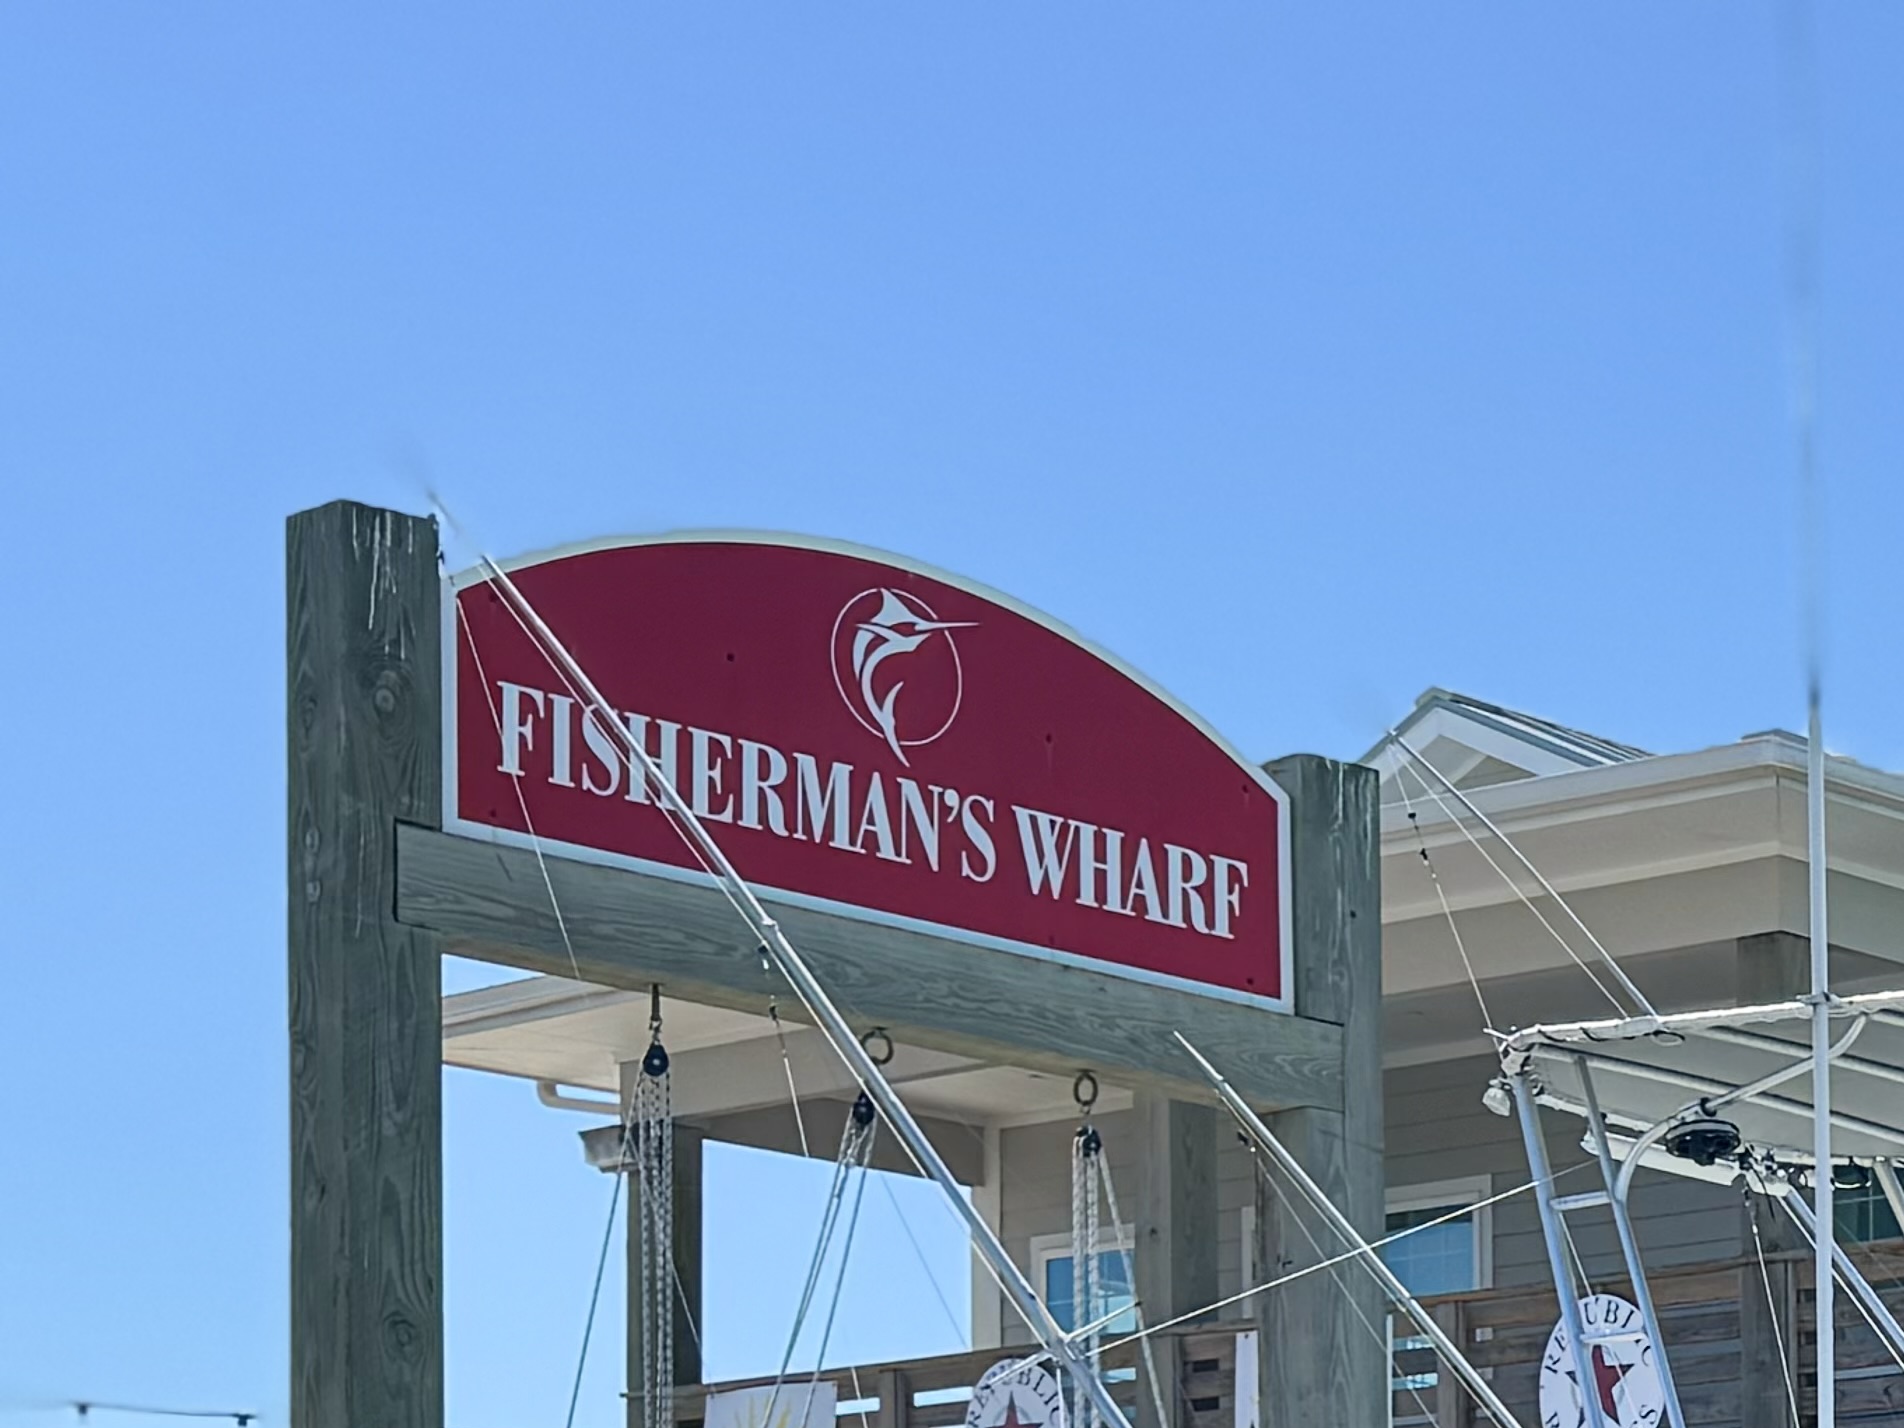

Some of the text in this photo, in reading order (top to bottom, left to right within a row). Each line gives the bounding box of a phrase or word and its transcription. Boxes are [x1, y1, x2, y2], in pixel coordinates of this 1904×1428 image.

[496, 680, 1249, 940] FISHERMAN'S WHARF
[1545, 1297, 1652, 1375] REUBLC
